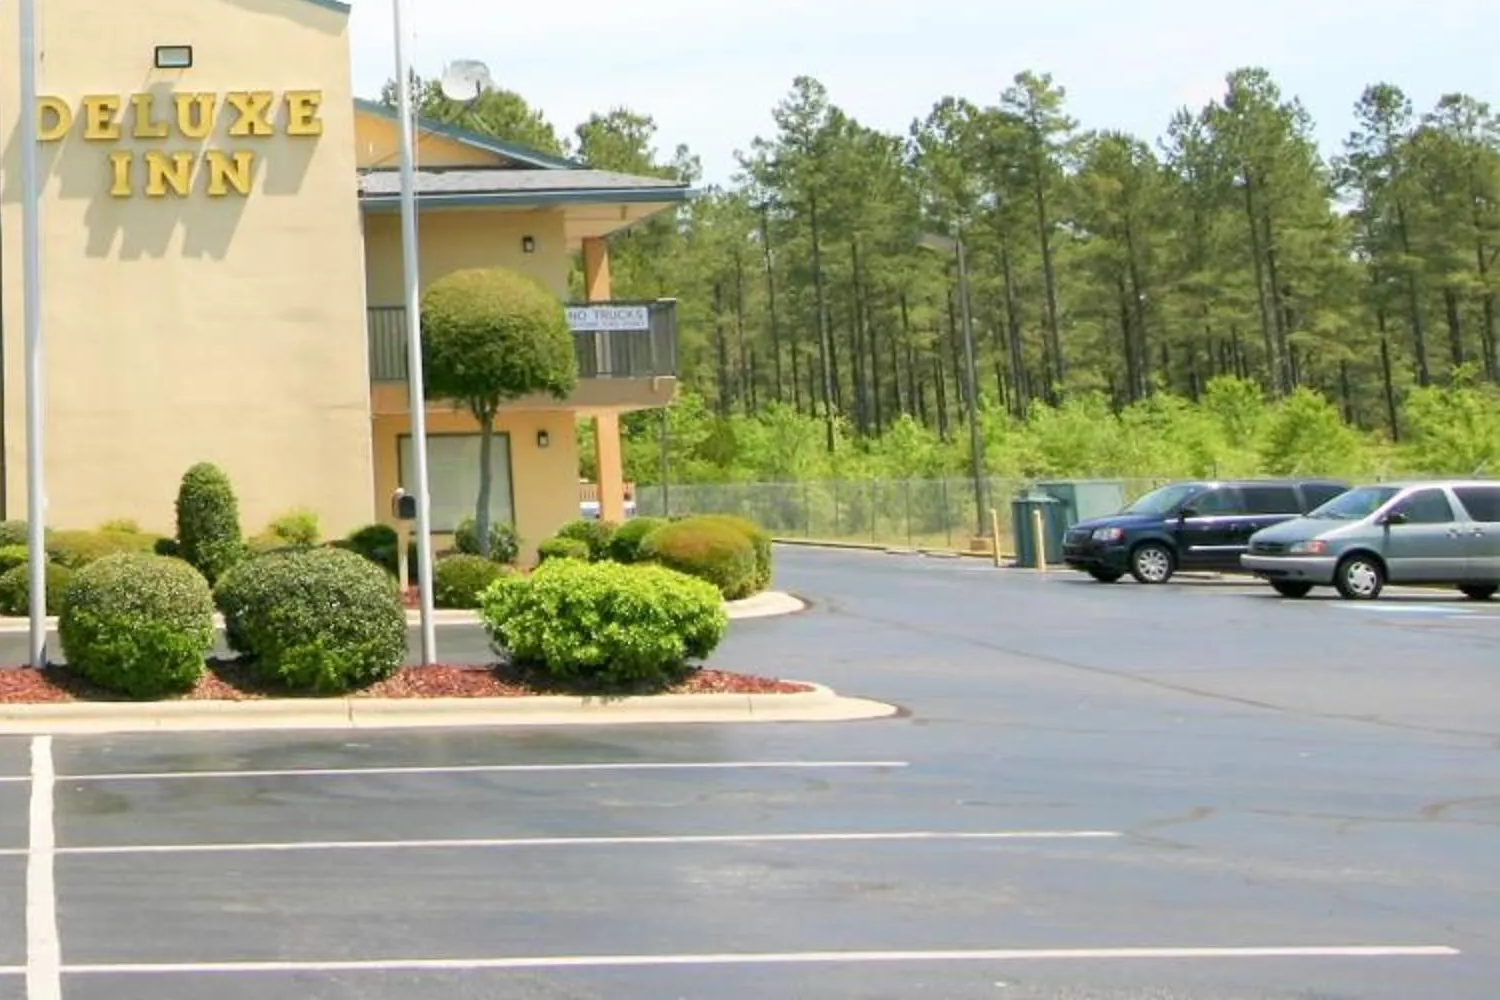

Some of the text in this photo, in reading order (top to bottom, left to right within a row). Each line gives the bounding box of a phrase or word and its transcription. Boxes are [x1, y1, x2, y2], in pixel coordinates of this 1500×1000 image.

[35, 90, 323, 141] DELUXE
[108, 150, 254, 196] INN
[567, 310, 644, 321] NO TRUCKS
